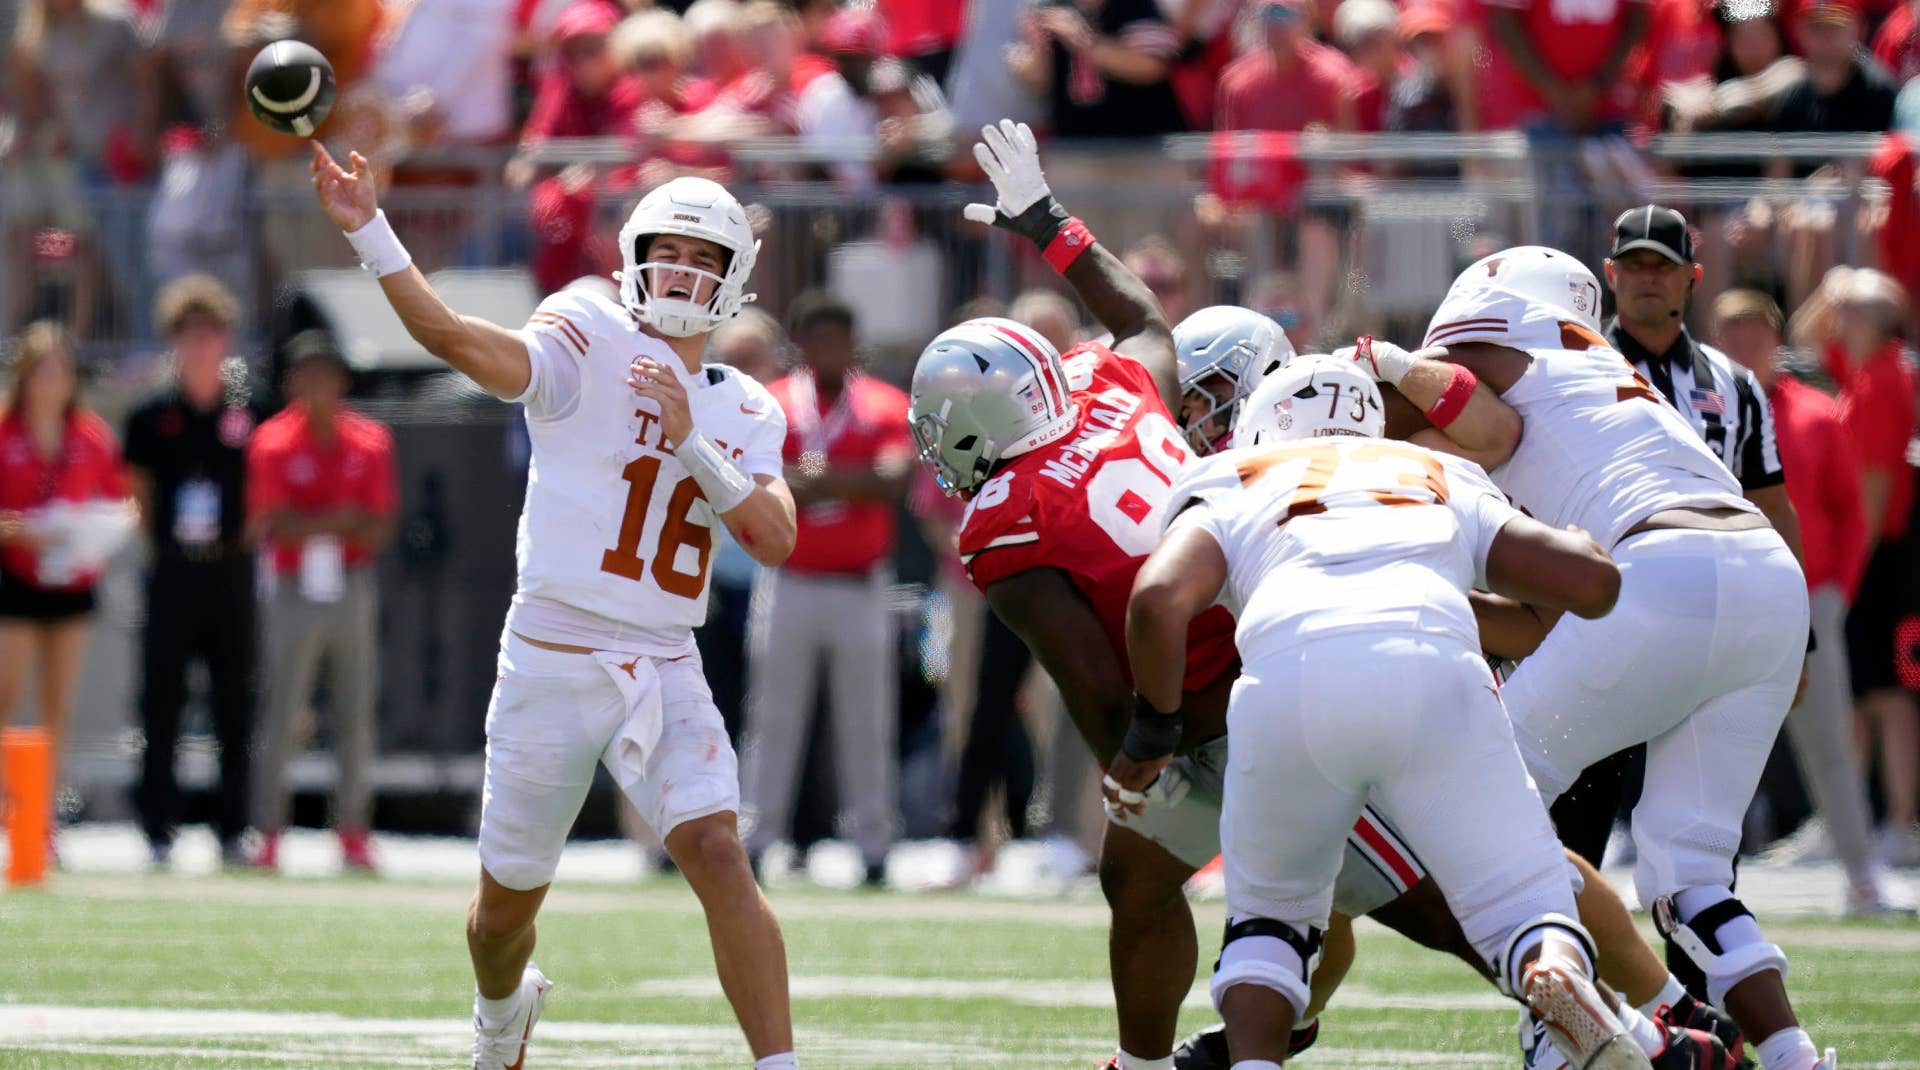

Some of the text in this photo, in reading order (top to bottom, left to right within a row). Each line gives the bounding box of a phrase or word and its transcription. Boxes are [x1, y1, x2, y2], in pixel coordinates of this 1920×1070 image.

[673, 213, 700, 223] HORNS
[1322, 383, 1365, 422] 73
[600, 454, 712, 600] 16
